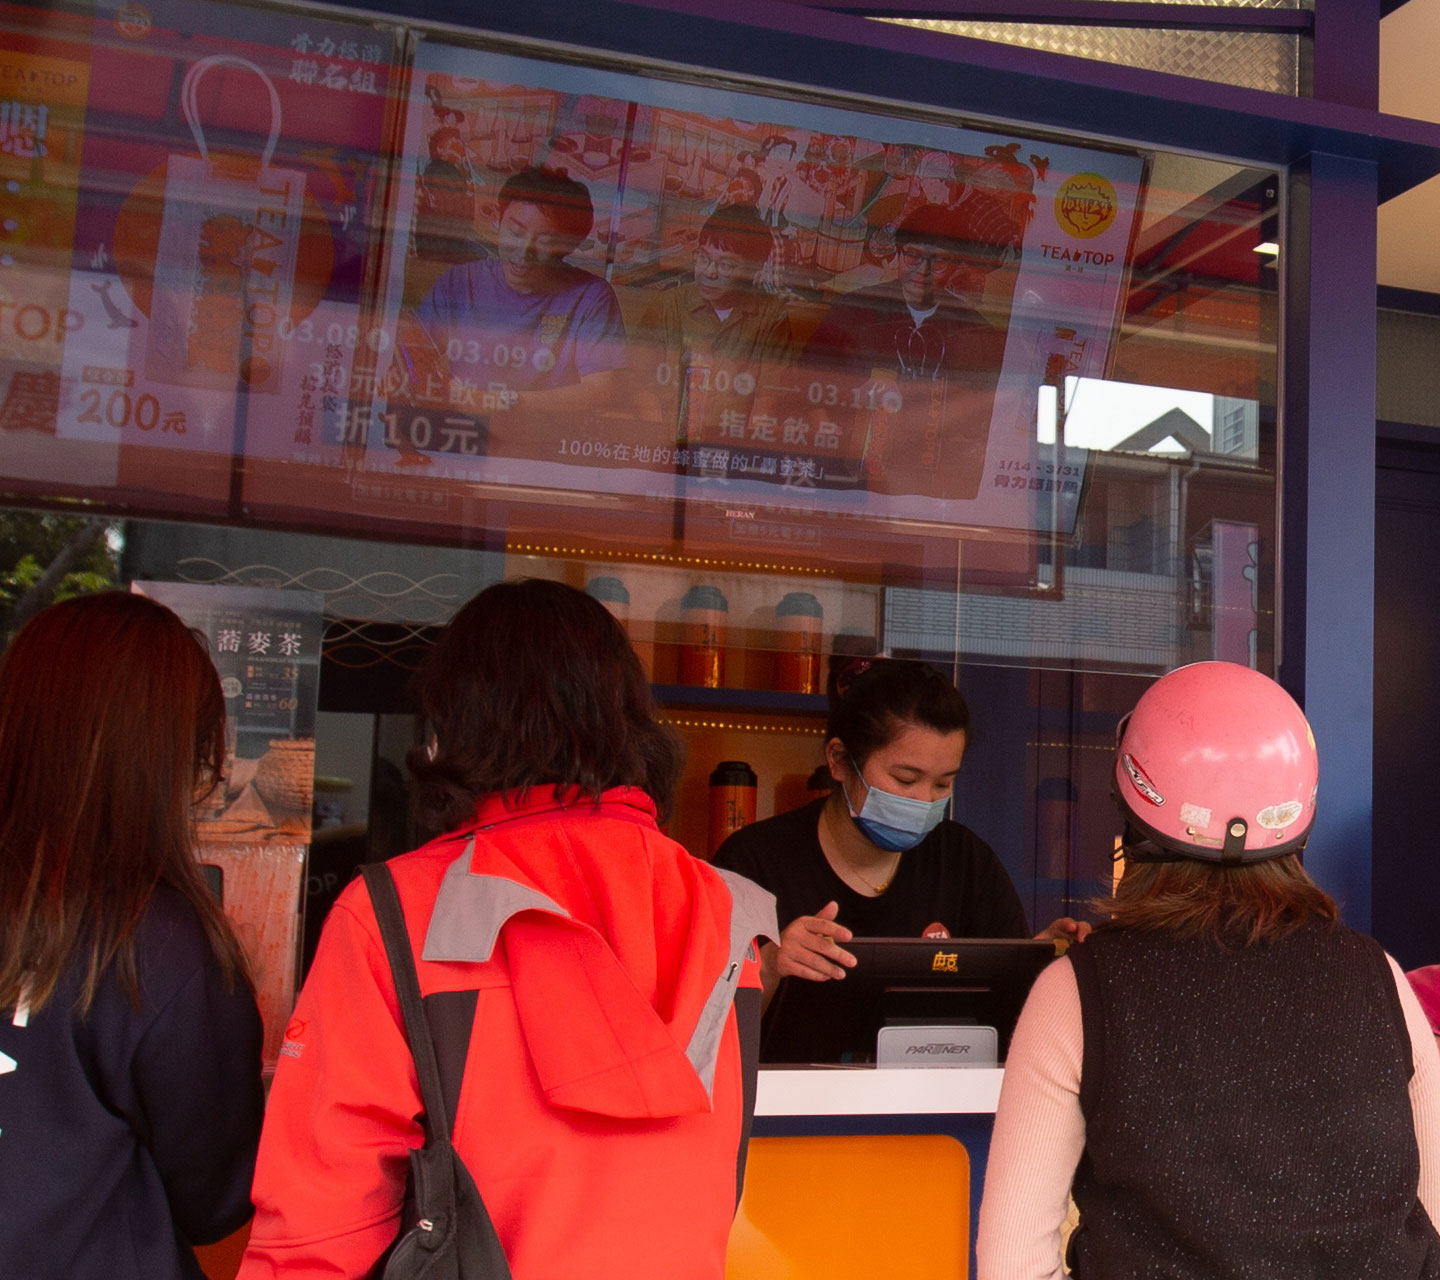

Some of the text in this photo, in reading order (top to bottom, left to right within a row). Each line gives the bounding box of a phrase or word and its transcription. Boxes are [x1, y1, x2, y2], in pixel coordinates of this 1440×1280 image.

[217, 628, 303, 656] 蕎麥茶
[906, 1043, 971, 1056] PARTNER
